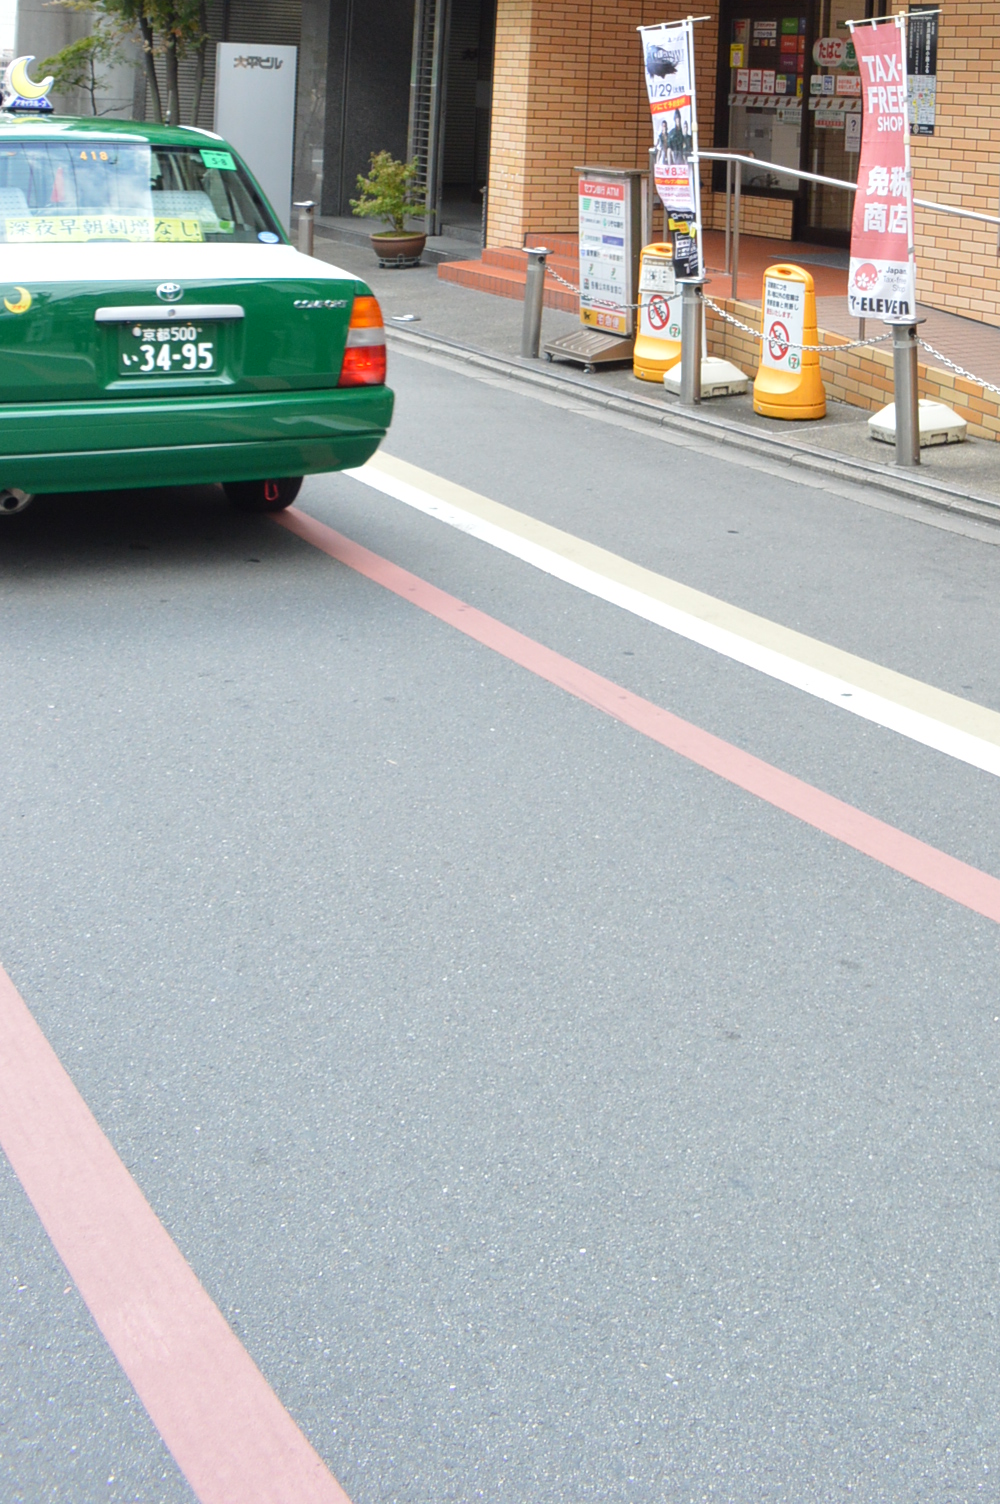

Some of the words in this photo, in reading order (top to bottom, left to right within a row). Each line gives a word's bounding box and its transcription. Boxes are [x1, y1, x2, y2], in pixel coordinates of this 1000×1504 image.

[818, 41, 842, 59] たばこ
[861, 53, 903, 83] TAX-
[867, 85, 905, 114] FREE
[877, 116, 903, 132] SHOP
[79, 151, 109, 161] 418
[606, 186, 620, 197] ATM
[866, 165, 909, 197] 免税
[593, 200, 621, 216] 京都銀行
[863, 202, 908, 234] 商店
[139, 342, 214, 372] 34-95
